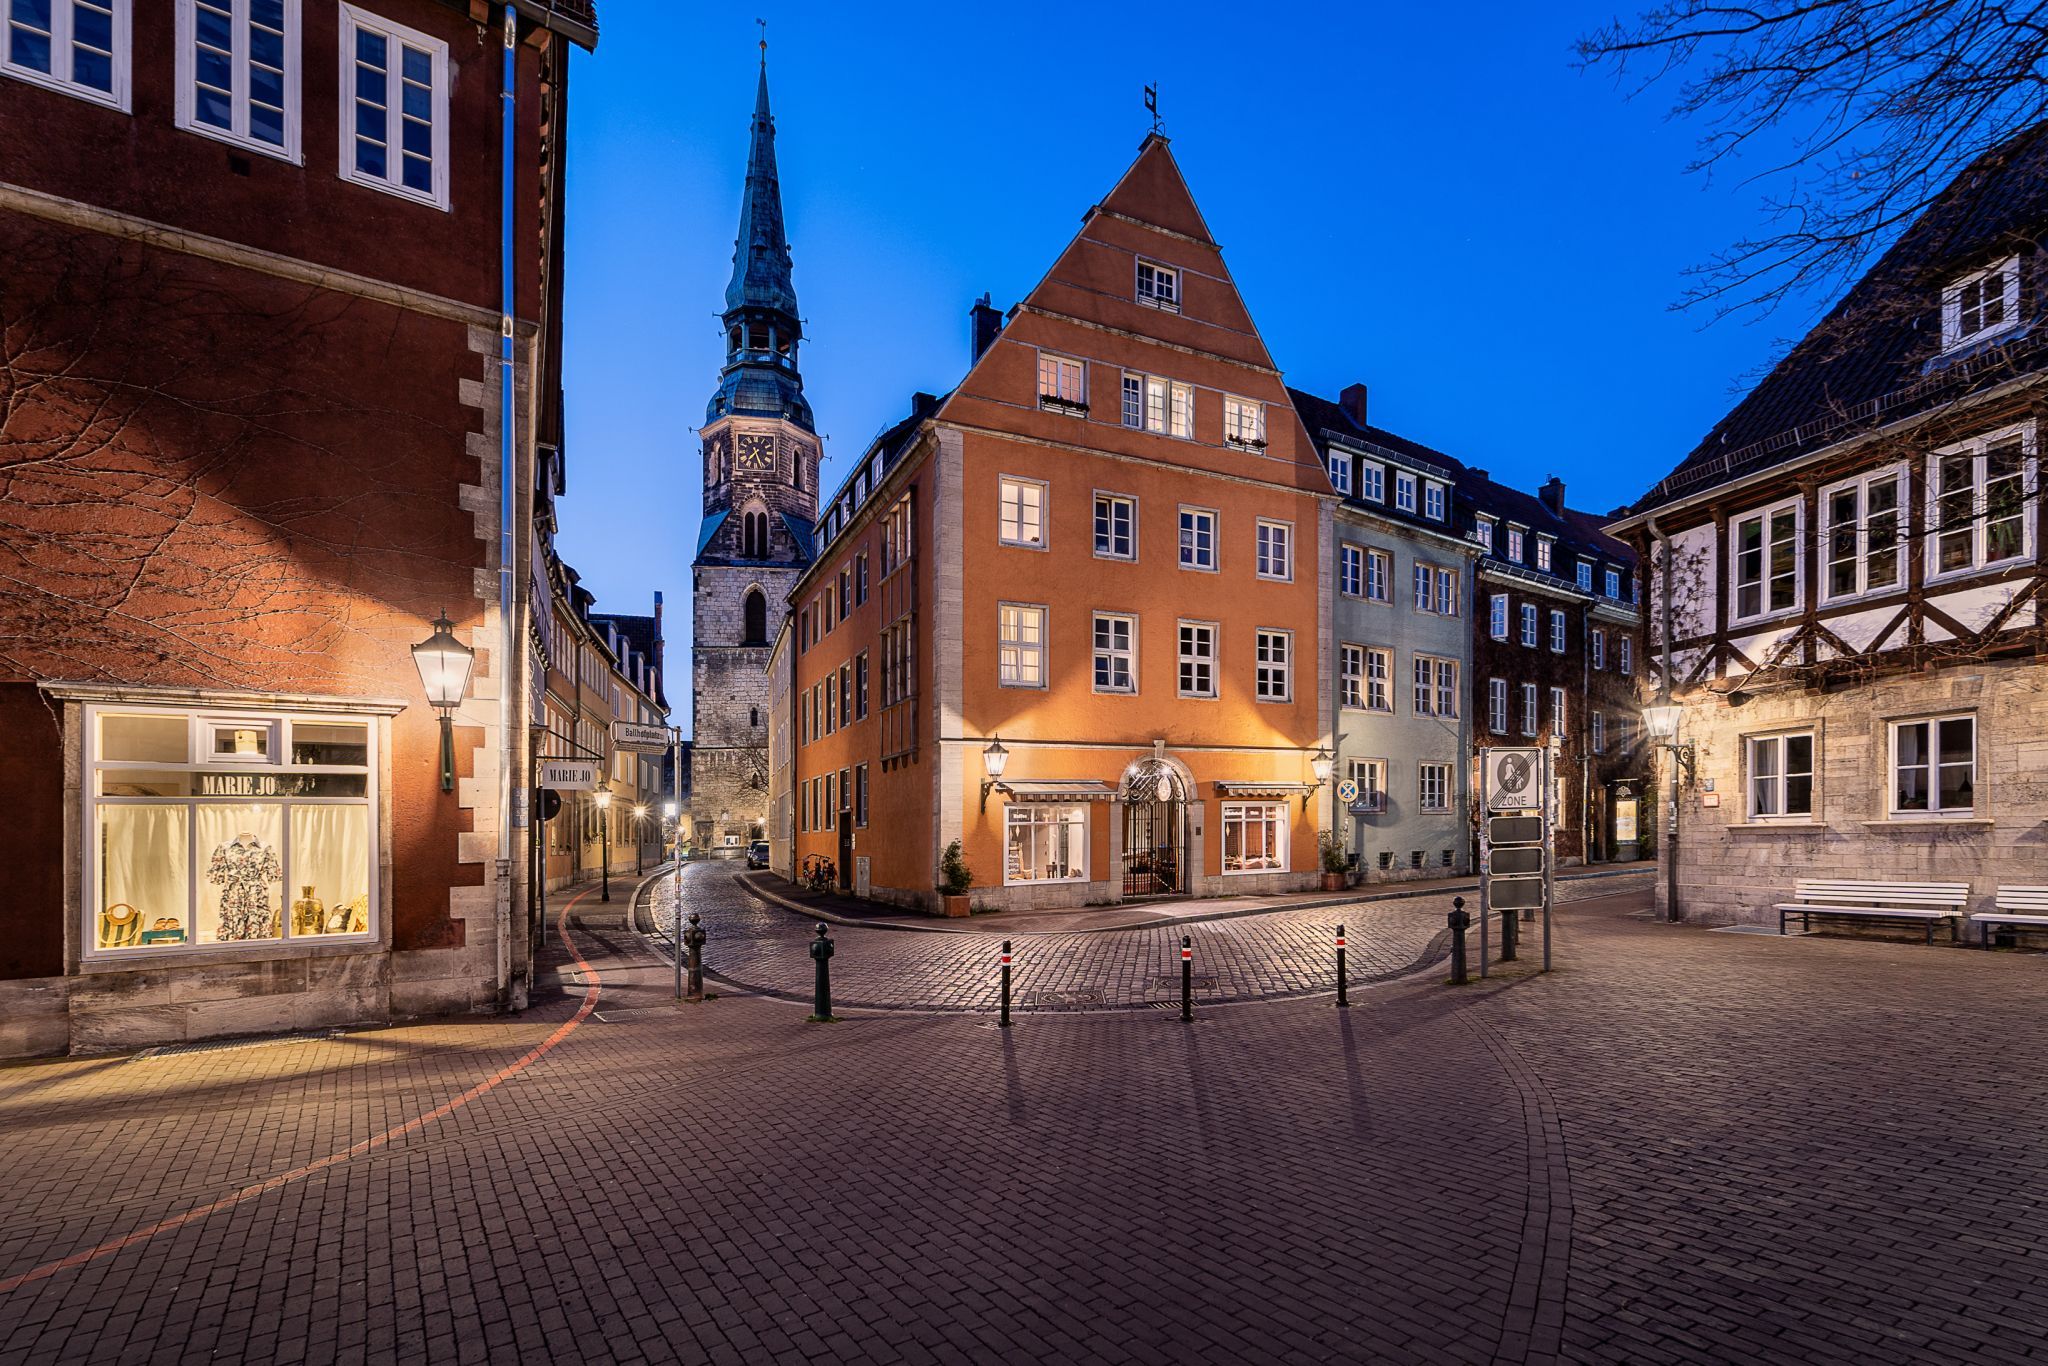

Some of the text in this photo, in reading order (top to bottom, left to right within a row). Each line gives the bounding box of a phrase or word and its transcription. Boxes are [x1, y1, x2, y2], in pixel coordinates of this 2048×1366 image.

[625, 727, 660, 740] Ballhofplatz
[549, 768, 591, 783] MARIE JO
[202, 775, 276, 795] MARIE JO
[1502, 795, 1527, 806] ZONE
